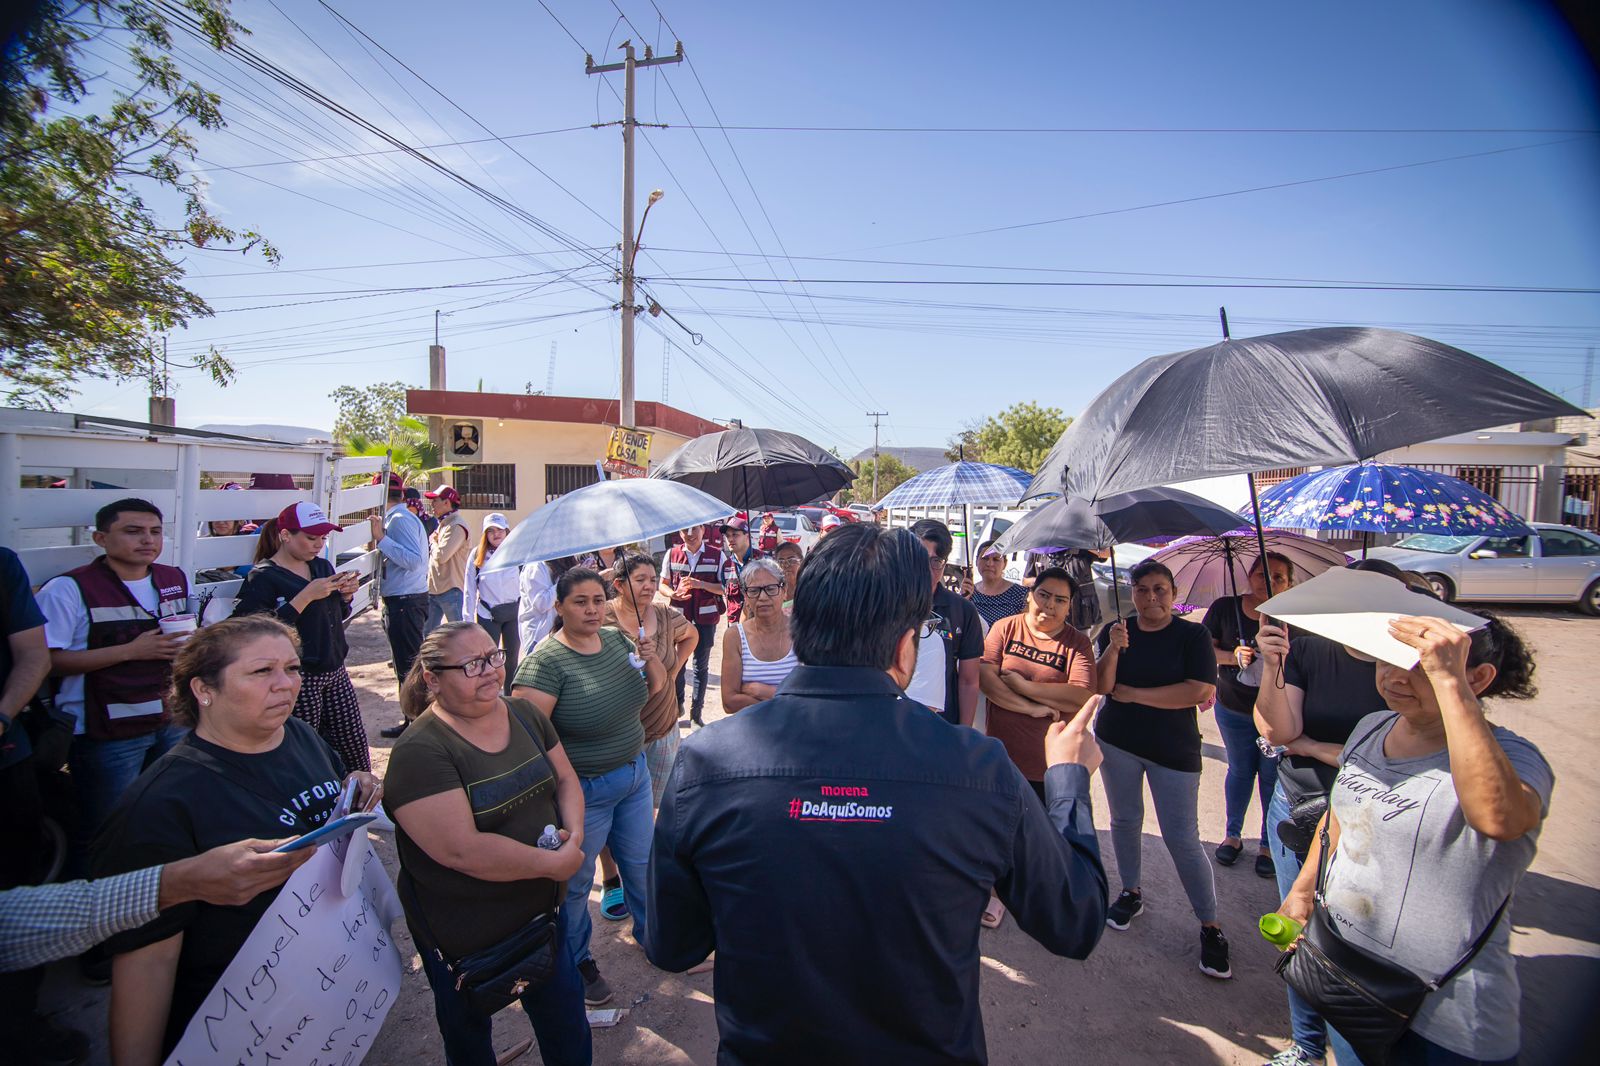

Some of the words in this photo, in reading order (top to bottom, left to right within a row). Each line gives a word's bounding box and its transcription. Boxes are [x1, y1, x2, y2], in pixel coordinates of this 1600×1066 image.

[620, 431, 649, 450] VENDE
[1009, 643, 1064, 667] BELIEVE
[820, 785, 869, 797] morena
[789, 798, 893, 819] #DeAquíSomos
[204, 913, 299, 1053] Miguel
[292, 882, 326, 918] de
[316, 952, 353, 992] de
